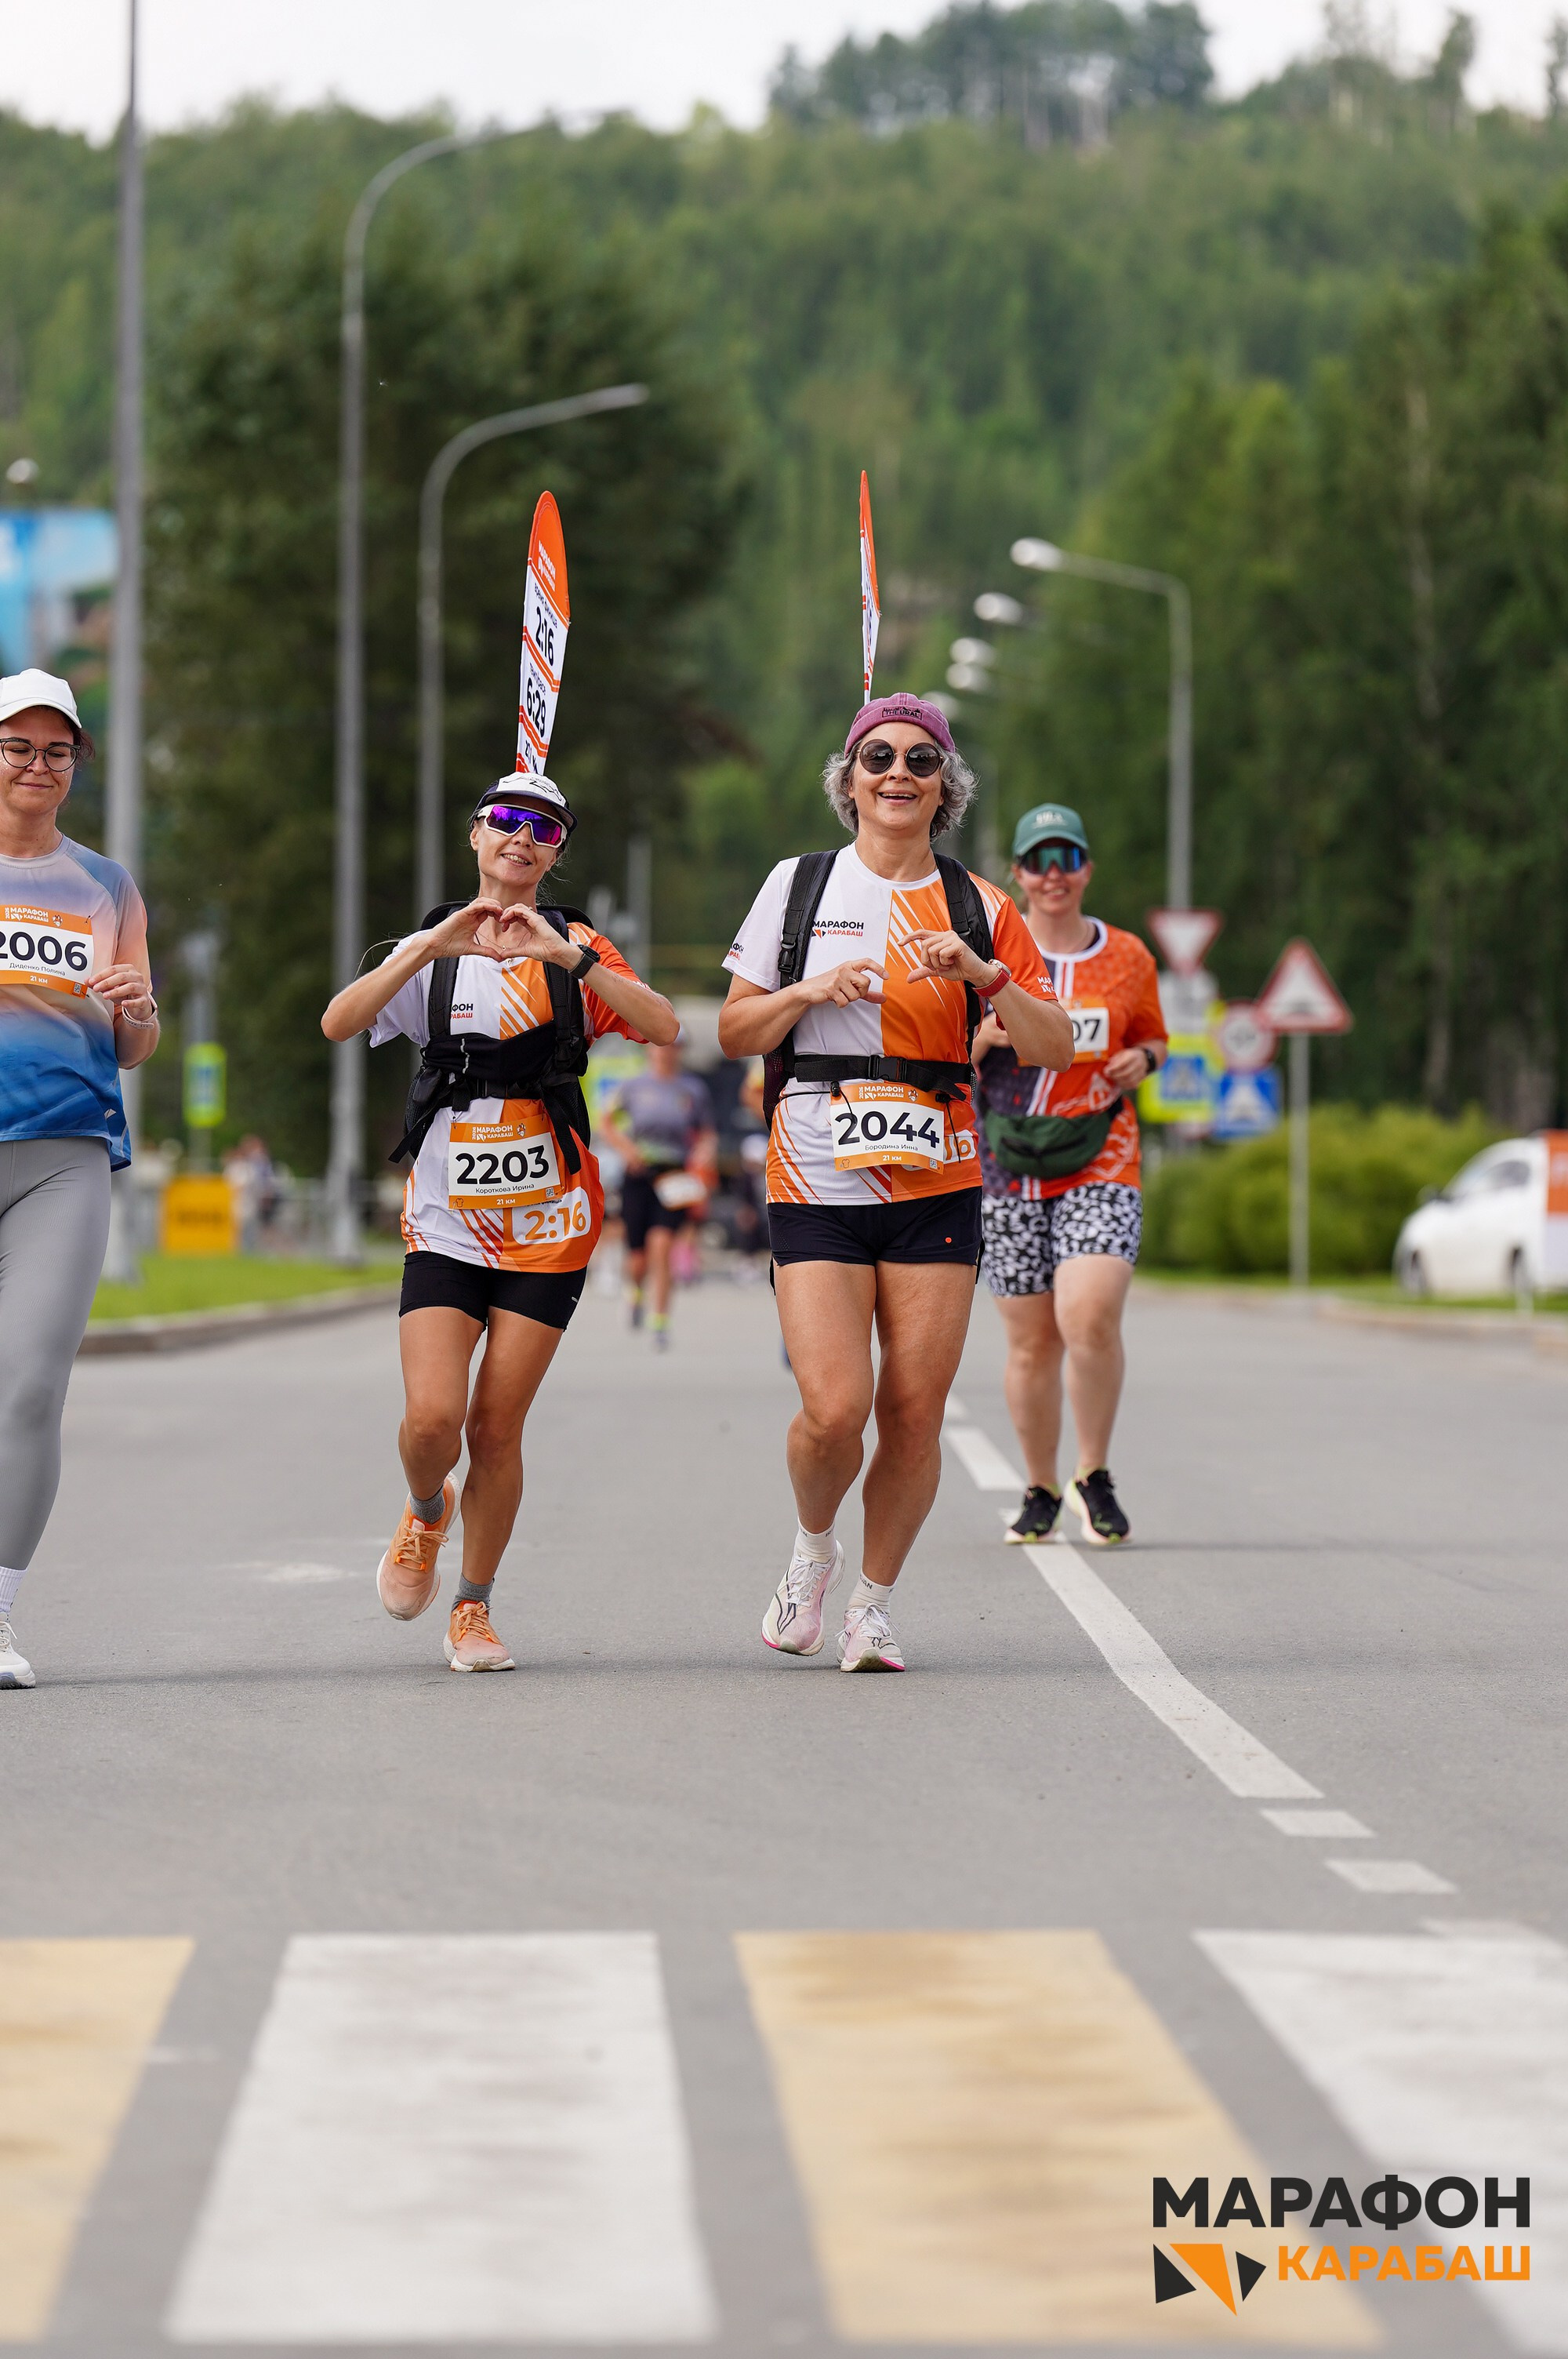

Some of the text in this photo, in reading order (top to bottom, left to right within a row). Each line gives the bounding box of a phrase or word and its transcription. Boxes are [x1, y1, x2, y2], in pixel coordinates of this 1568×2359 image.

[535, 605, 554, 667] 2:16
[527, 677, 546, 738] 6:29
[10, 907, 49, 918] МАРАФОН
[24, 914, 49, 922] КАРАБАШ
[813, 920, 864, 930] МАРАФОН
[0, 931, 88, 972] 2006
[9, 962, 66, 976] Диденко Полина
[476, 1125, 513, 1134] МАРАФОН
[835, 1110, 940, 1148] 2044
[455, 1144, 550, 1185] 2203
[512, 1183, 535, 1192] Ирина
[524, 1201, 586, 1241] 2:16
